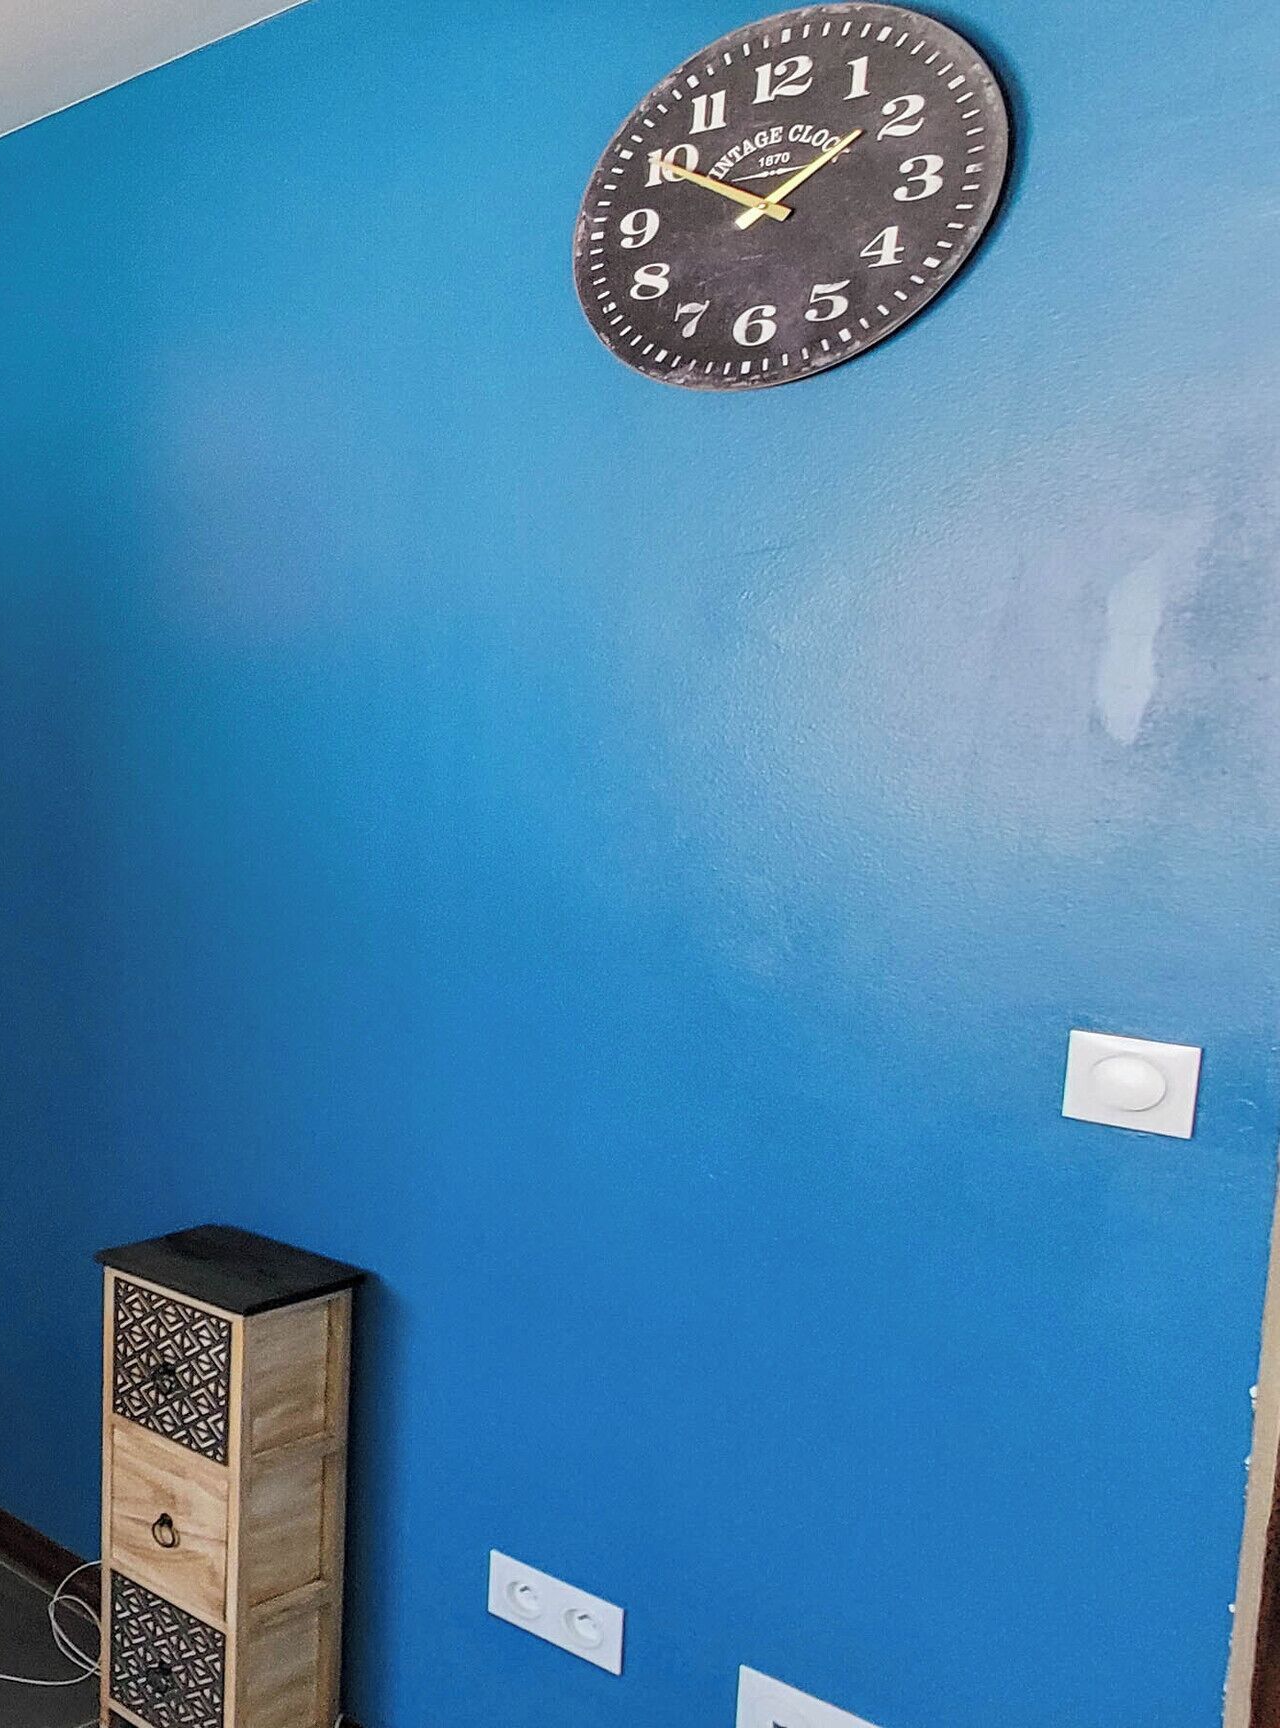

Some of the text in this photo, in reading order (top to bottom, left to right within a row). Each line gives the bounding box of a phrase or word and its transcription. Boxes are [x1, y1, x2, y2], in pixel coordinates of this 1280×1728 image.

[751, 55, 814, 105] 12
[842, 56, 872, 100] 1
[689, 90, 727, 135] 11
[877, 94, 926, 141] 2
[644, 143, 700, 188] 10
[706, 126, 784, 181] INTAGE
[758, 151, 790, 168] 1870
[893, 154, 944, 201] 3
[619, 208, 660, 249] 9
[859, 225, 905, 268] 4
[629, 262, 671, 301] 8
[804, 279, 852, 322] 5
[674, 300, 711, 338] 7
[732, 304, 778, 347] 6
